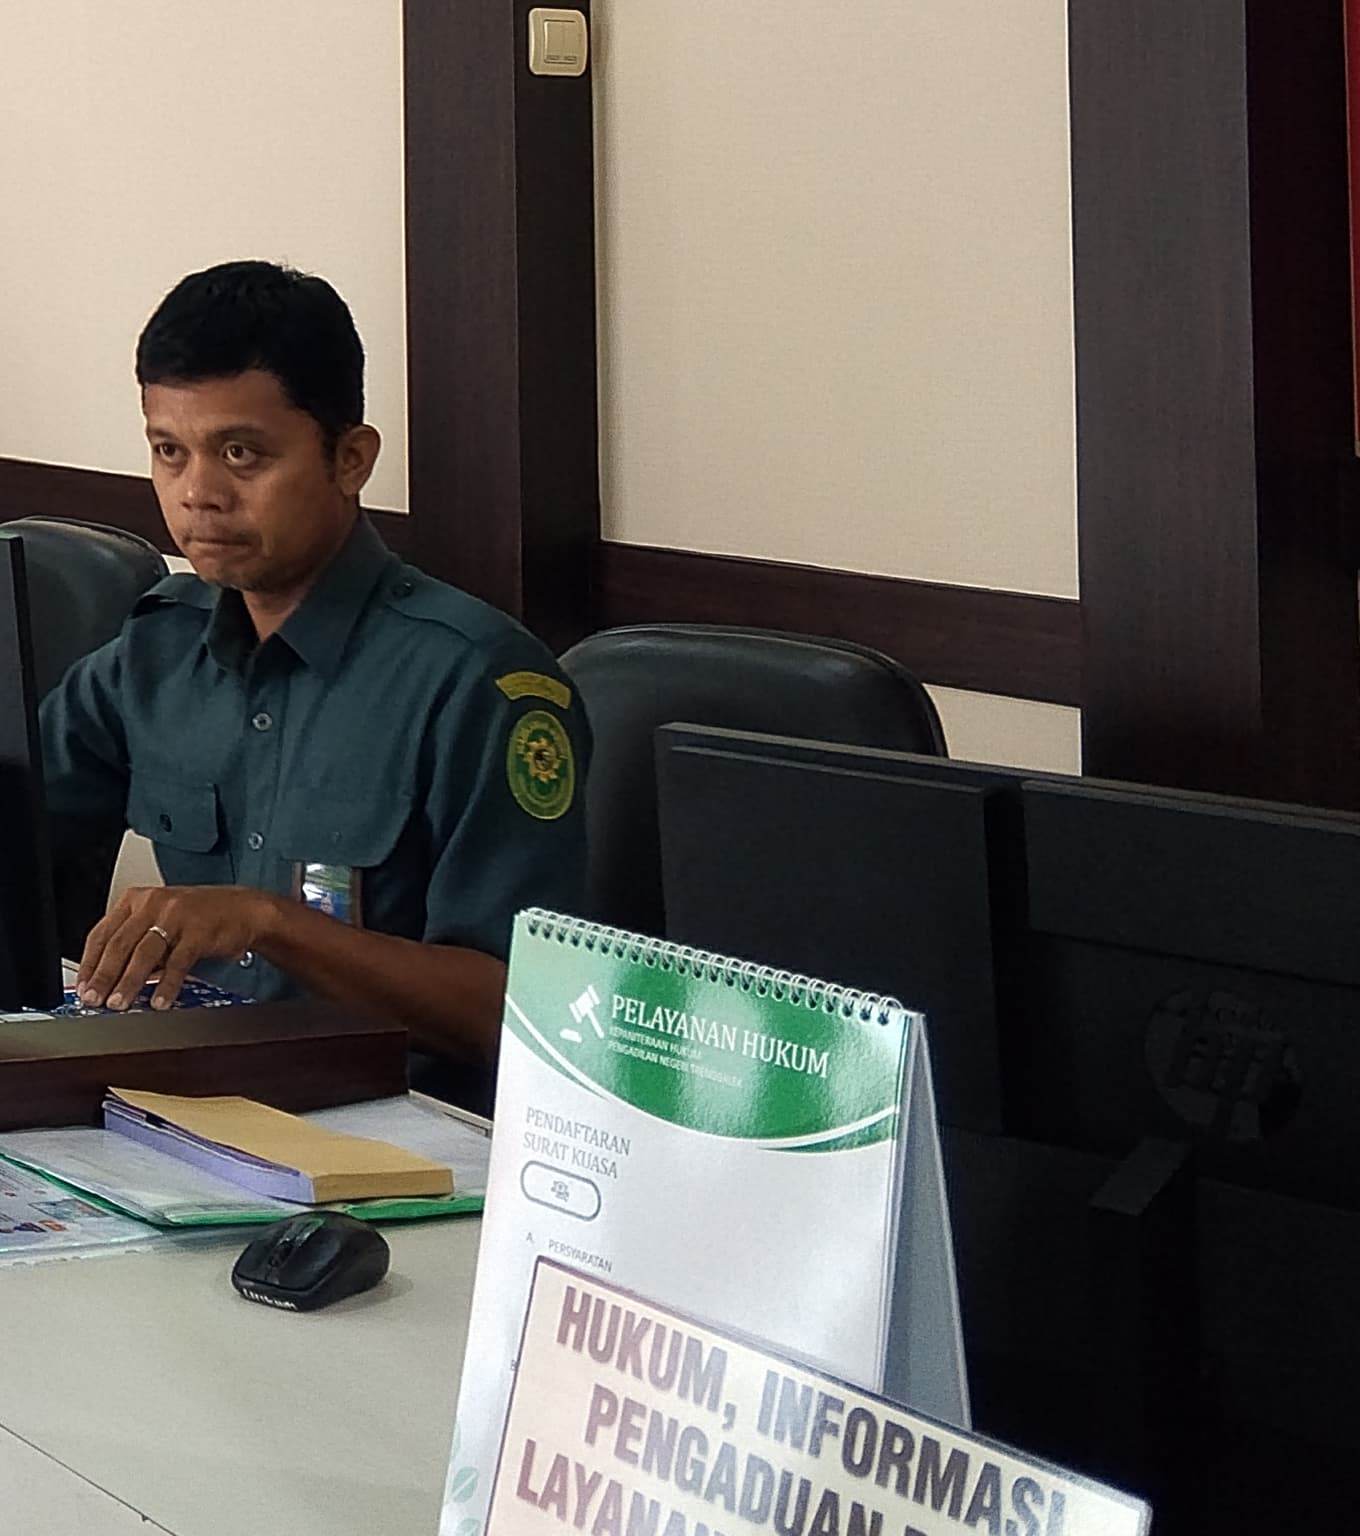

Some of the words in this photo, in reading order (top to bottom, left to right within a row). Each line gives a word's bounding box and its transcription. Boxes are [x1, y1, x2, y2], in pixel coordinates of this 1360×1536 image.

[608, 1040, 656, 1064] PENGADILAN
[659, 1053, 689, 1072] NEGERI
[610, 1026, 668, 1051] KEPANITERAAN
[670, 1039, 701, 1060] HUKUM
[611, 994, 736, 1051] PELAYANAN
[742, 1030, 830, 1079] HUKUM
[523, 1131, 569, 1162] SURAT
[572, 1148, 619, 1179] KUASA
[526, 1106, 631, 1156] PENDAFTARAN
[548, 1239, 613, 1273] PERSYARATAN
[557, 1286, 736, 1430] HUKUM,
[756, 1369, 1067, 1536] INFORMASI
